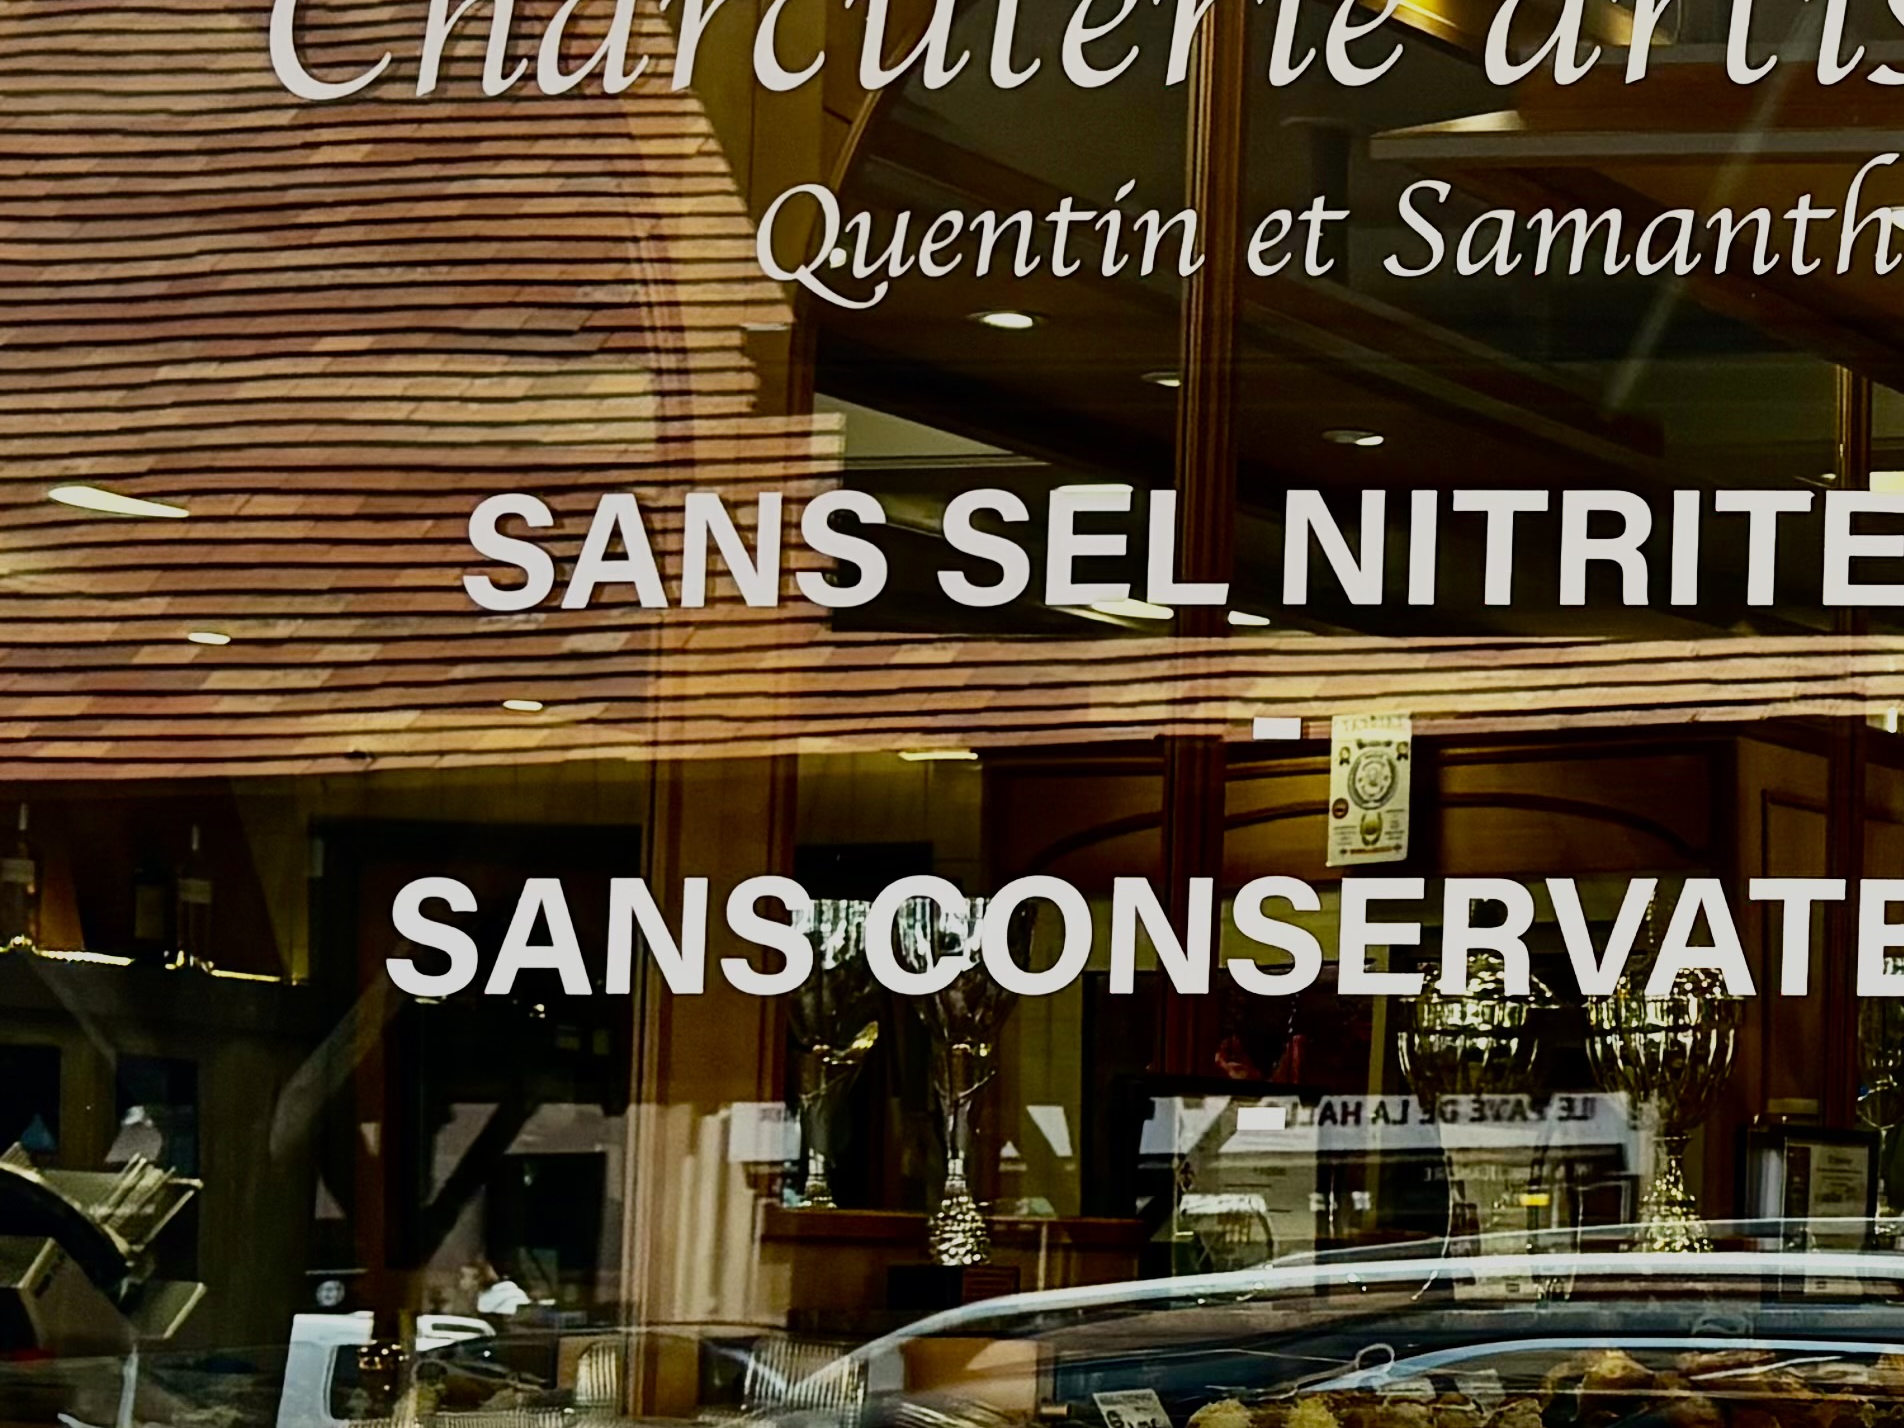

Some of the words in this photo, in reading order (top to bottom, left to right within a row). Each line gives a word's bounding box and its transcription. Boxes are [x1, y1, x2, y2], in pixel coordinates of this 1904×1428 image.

[756, 179, 1205, 309] Quentin
[1247, 195, 1350, 276] et
[463, 490, 888, 611] SANS
[937, 489, 1230, 607] SEL
[386, 876, 815, 997] SANS
